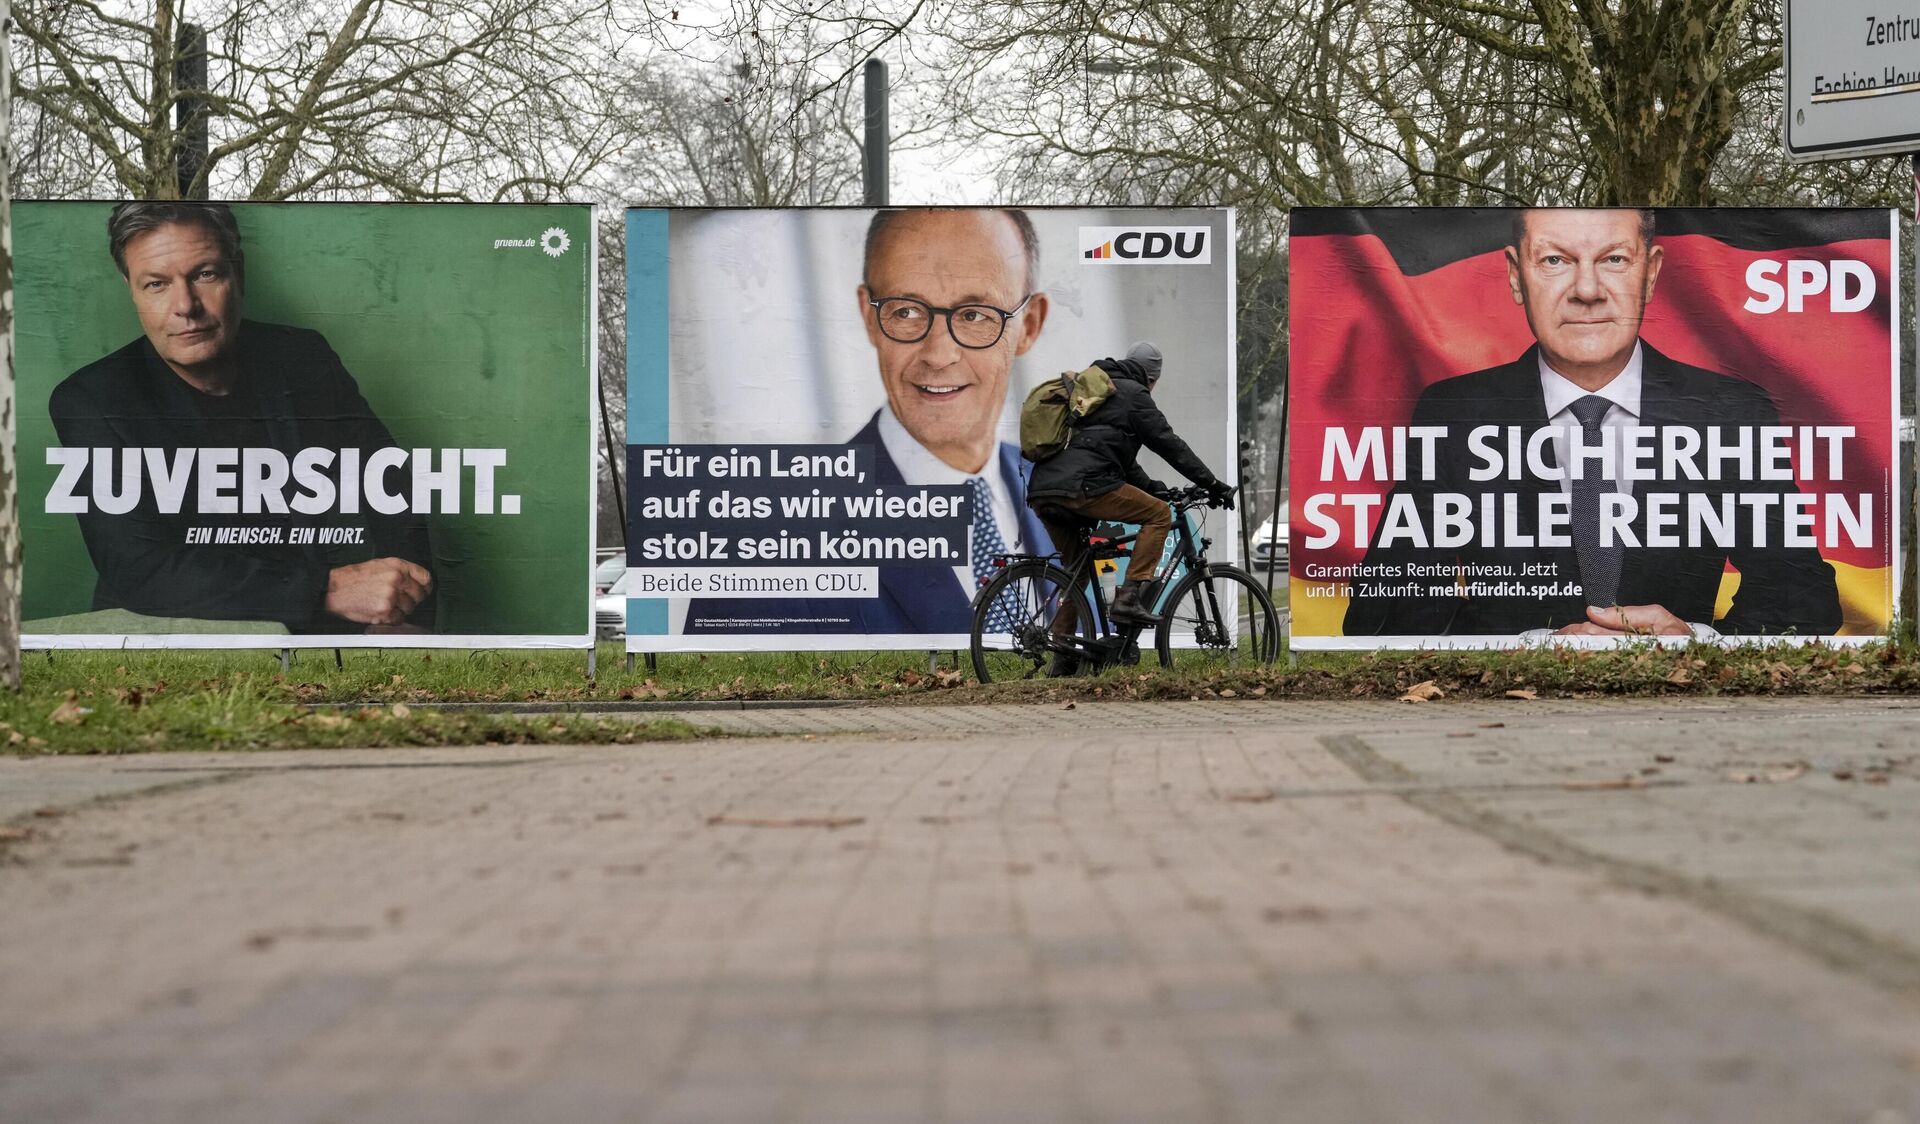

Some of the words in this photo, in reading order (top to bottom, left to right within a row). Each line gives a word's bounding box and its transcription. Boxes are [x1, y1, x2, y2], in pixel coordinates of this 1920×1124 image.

[1885, 66, 1920, 86] Hou
[494, 238, 536, 249] gruene.de
[1114, 232, 1205, 259] CDU
[1744, 260, 1876, 314] SPD
[643, 448, 701, 478] Für
[708, 449, 761, 478] ein
[771, 449, 866, 484] Land,
[1320, 426, 1448, 481] MIT
[1468, 425, 1856, 481] SICHERHEIT
[45, 447, 521, 515] ZUVERSICHT.
[643, 489, 701, 519] auf
[709, 489, 772, 519] das
[780, 489, 837, 519] wir
[844, 489, 965, 519] wieder
[1303, 493, 1572, 550] STABILE
[1600, 493, 1873, 550] RENTEN
[186, 528, 213, 544] EIN
[215, 528, 284, 544] MENSCH.
[288, 528, 316, 544] EIN
[318, 528, 365, 544] WORT.
[643, 530, 729, 560] stolz
[737, 530, 811, 560] sein
[820, 530, 959, 560] können.
[642, 573, 704, 593] Beide
[709, 573, 808, 593] Stimmen
[815, 573, 867, 593] CDU.
[1305, 562, 1402, 579] Garantiertes
[1408, 562, 1517, 578] Rentenniveau.
[1520, 562, 1558, 578] Jetzt
[1306, 582, 1335, 598] und
[1340, 582, 1354, 598] in
[1359, 582, 1425, 598] Zukunft:
[1429, 581, 1583, 600] mehrfürdich.spd.de
